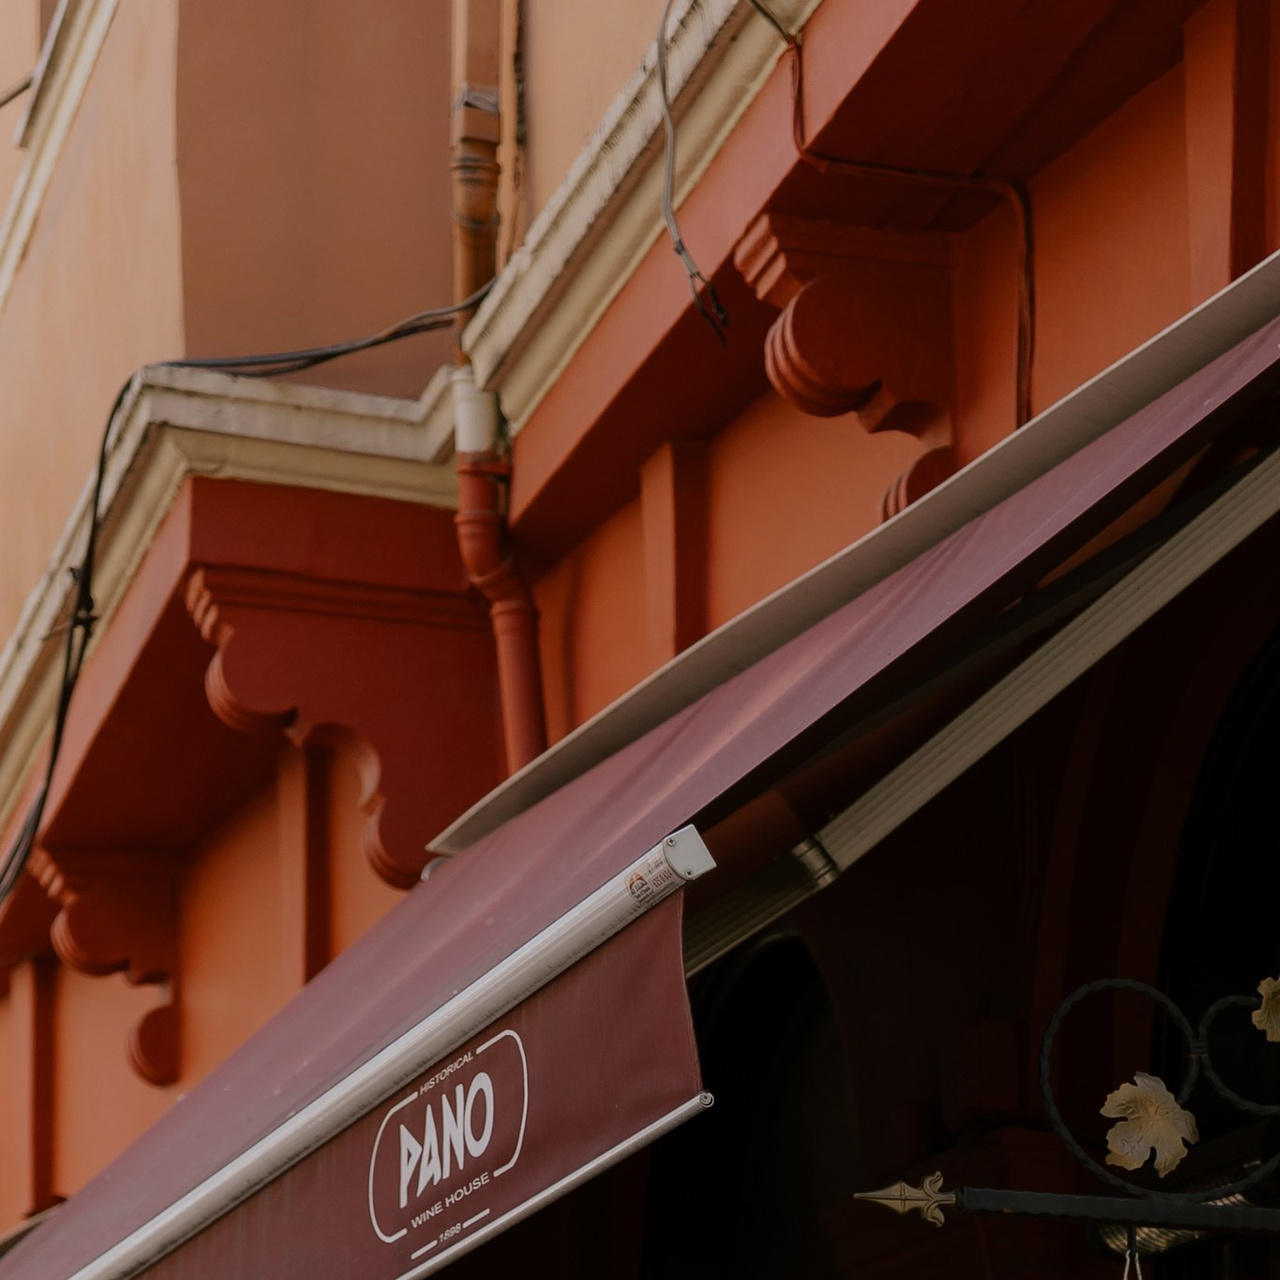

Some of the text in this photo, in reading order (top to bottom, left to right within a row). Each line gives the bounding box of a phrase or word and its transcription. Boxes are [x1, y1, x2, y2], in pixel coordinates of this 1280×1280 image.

[419, 1050, 474, 1096] HISTORICAL
[400, 1071, 494, 1209] PANO
[410, 1171, 490, 1229] WINE HOUSE
[438, 1222, 462, 1243] 1898
